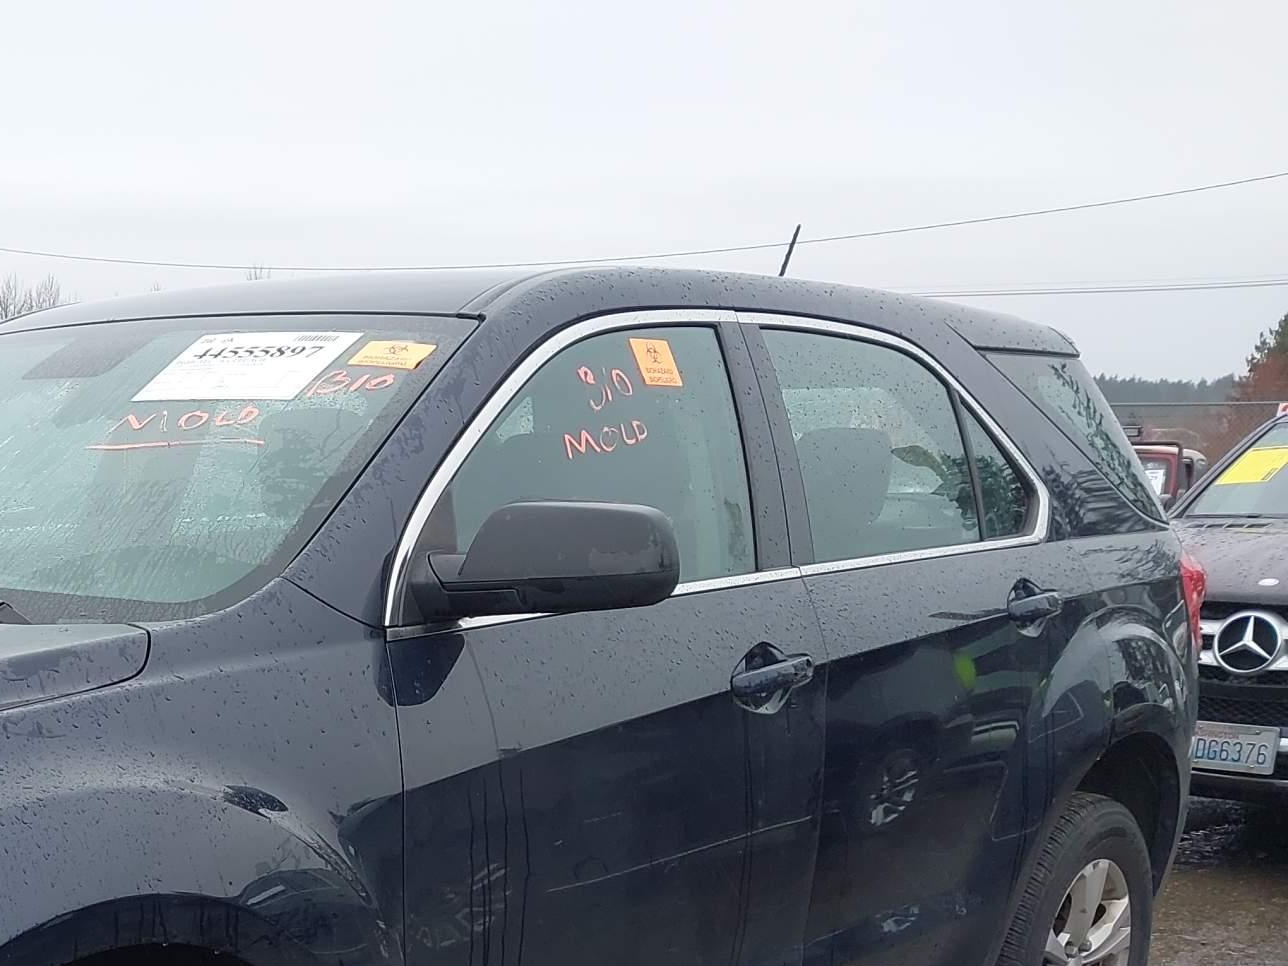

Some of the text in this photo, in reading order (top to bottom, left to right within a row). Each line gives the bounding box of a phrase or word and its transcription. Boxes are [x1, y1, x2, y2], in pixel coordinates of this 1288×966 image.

[193, 345, 326, 359] 44555897
[563, 420, 649, 460] MOLD
[1193, 737, 1269, 765] DG6376
